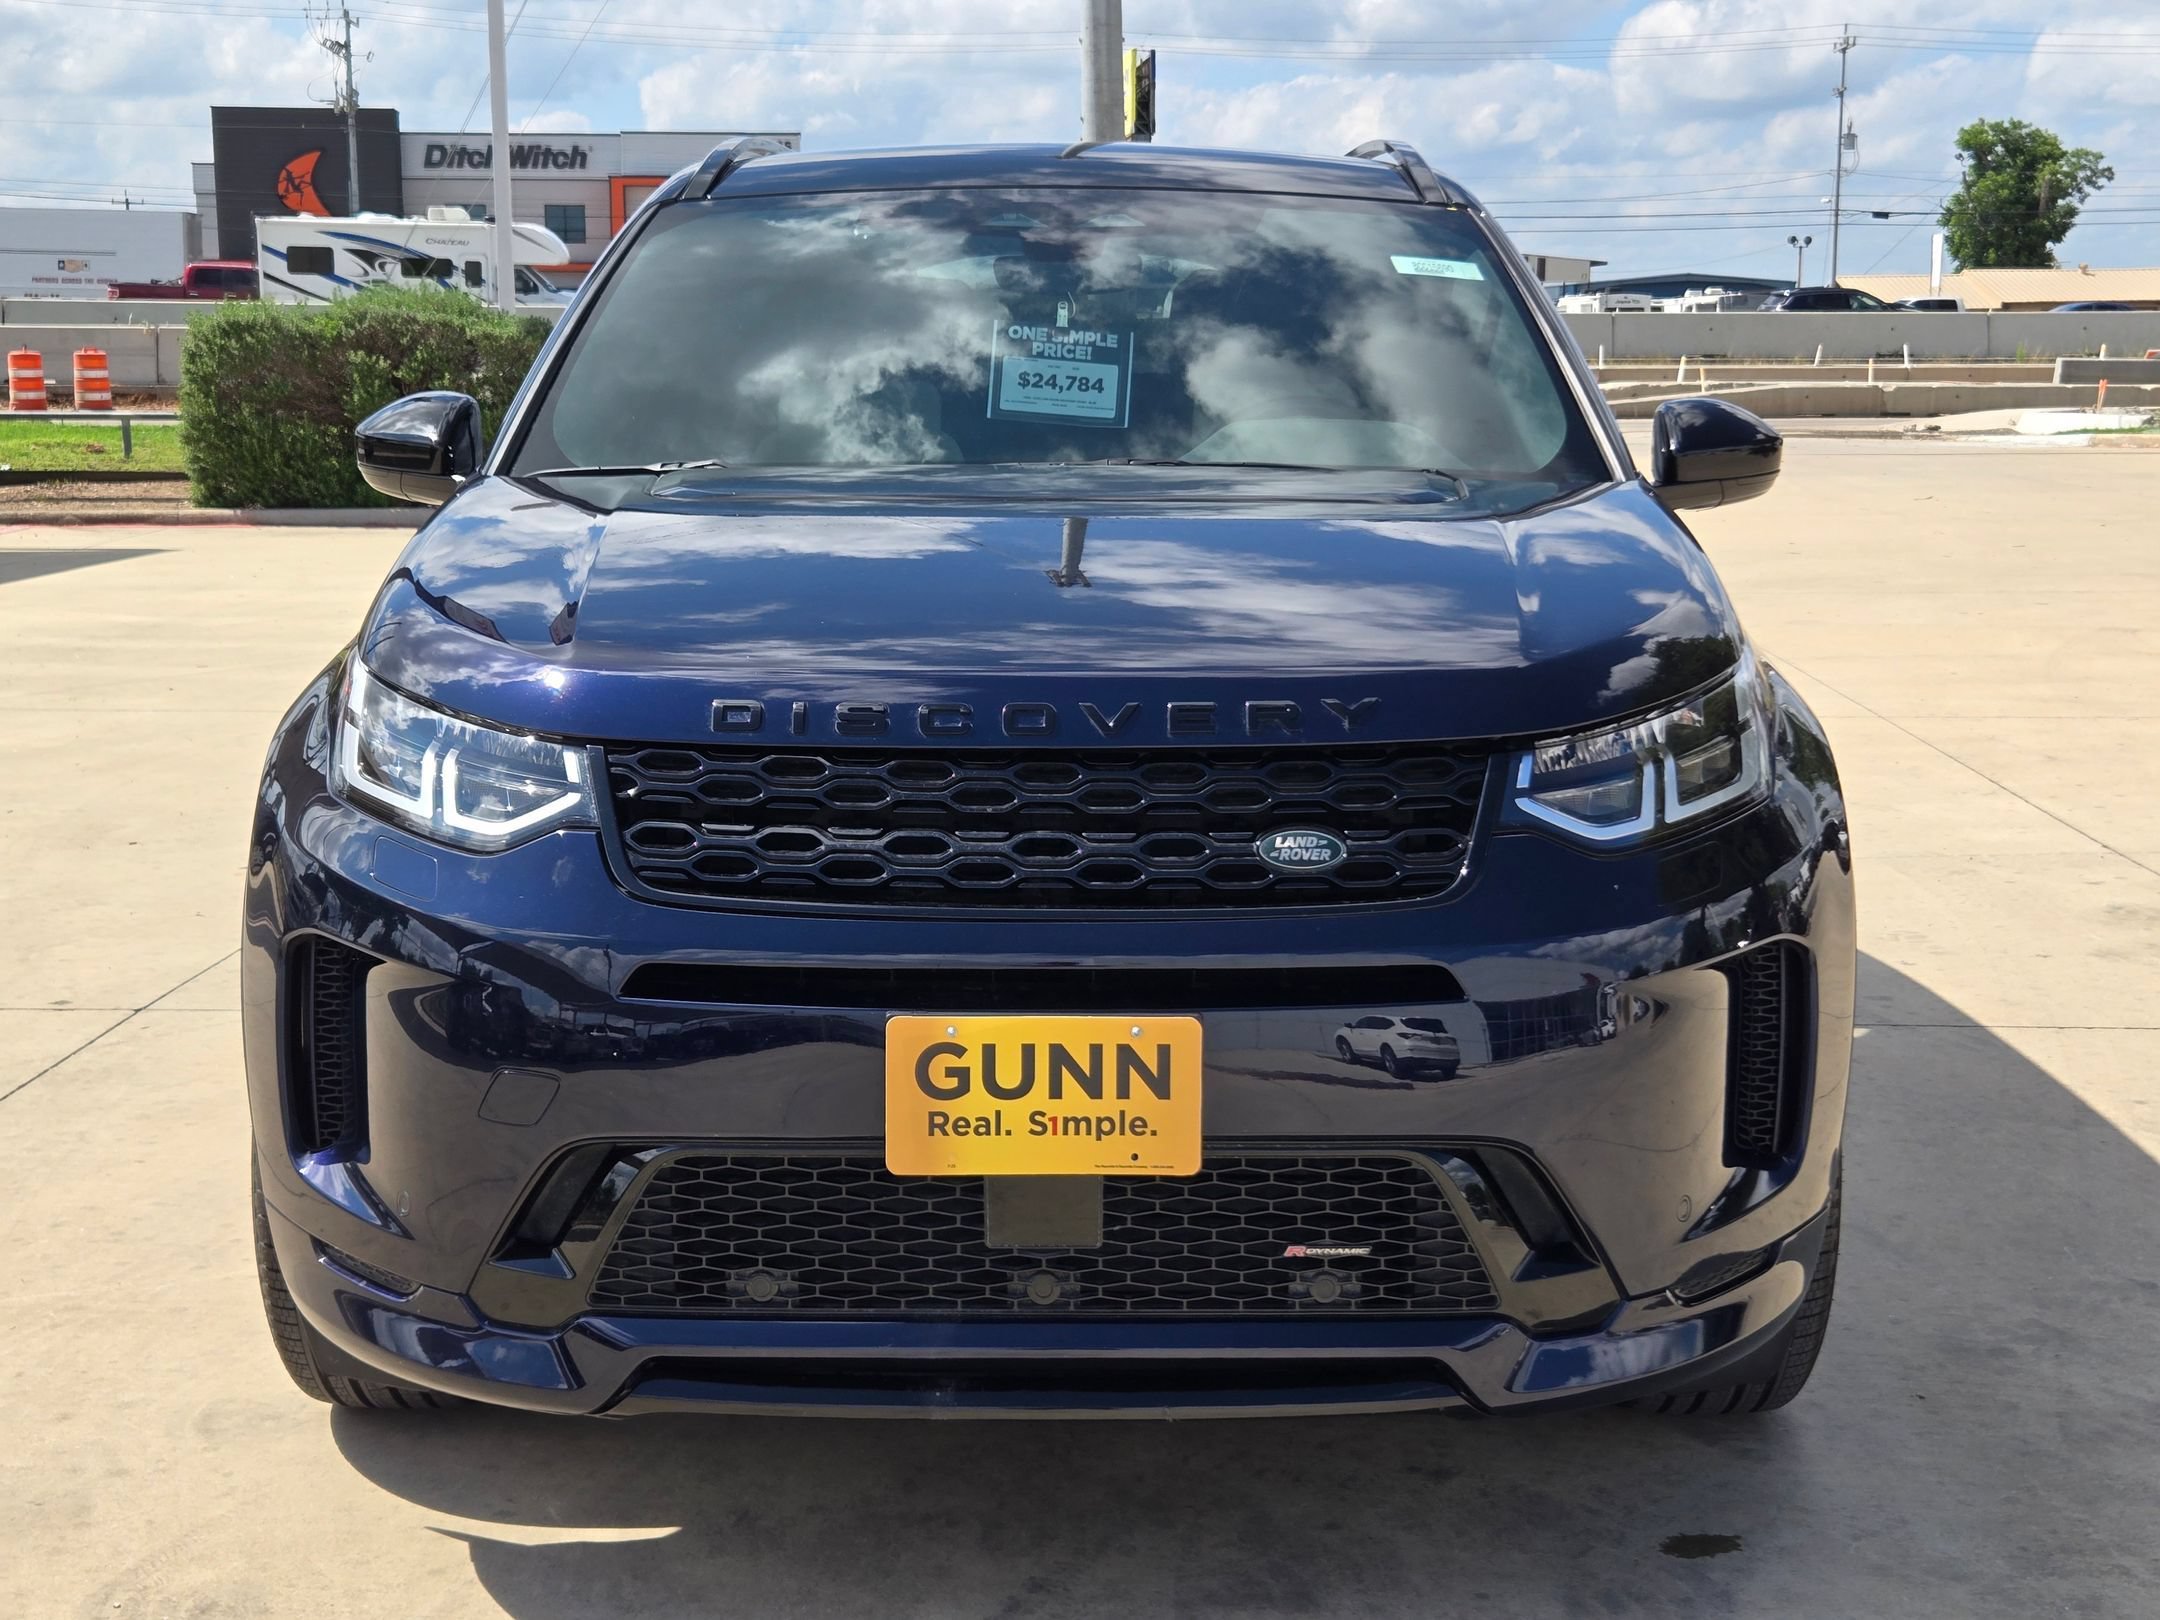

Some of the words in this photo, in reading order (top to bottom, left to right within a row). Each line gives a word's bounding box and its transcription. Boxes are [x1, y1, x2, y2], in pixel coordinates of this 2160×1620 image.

[1008, 325, 1048, 341] ONE
[1032, 341, 1093, 360] PRICE!
[1017, 370, 1105, 394] $24,784
[709, 696, 1383, 737] DISCOVERY
[1274, 836, 1318, 848] LAND
[1278, 848, 1332, 861] ROVER
[914, 1041, 1172, 1101] GUNN
[927, 1110, 1012, 1137] Real.
